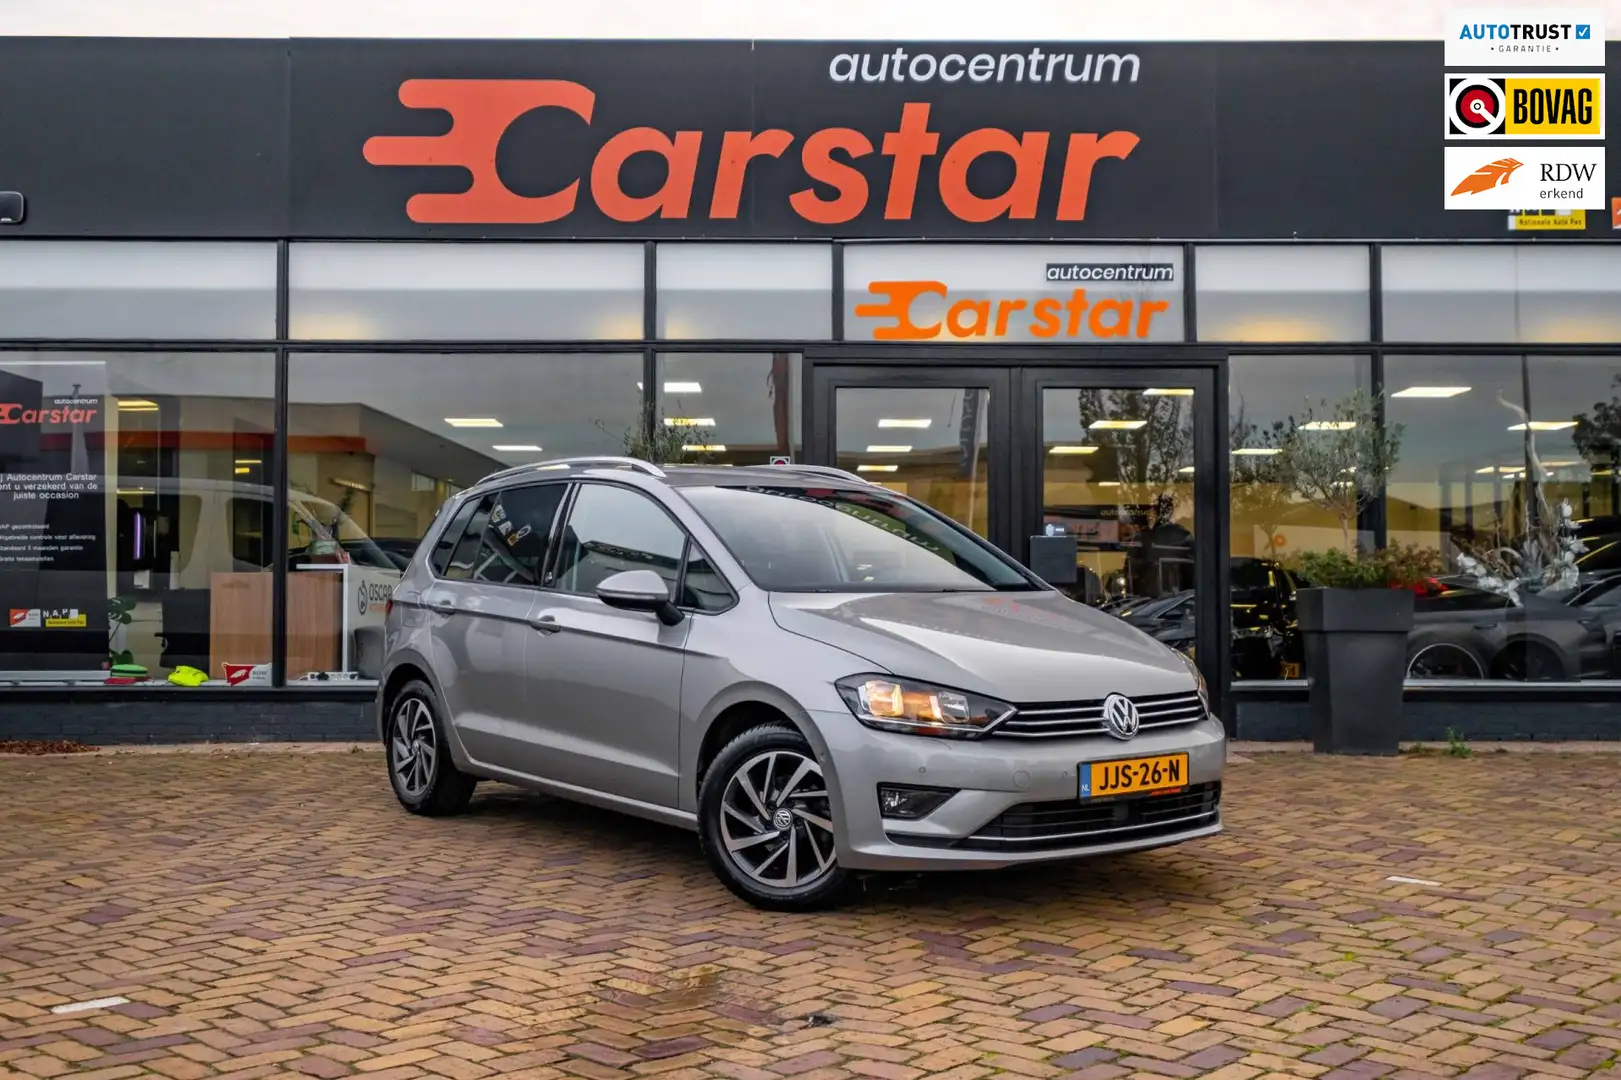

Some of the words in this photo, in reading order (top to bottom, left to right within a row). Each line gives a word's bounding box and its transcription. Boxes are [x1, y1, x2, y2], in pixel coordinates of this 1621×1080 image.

[829, 46, 1141, 85] autocentrum
[363, 78, 1141, 225] Carstar
[1047, 264, 1174, 281] autocentrum
[854, 280, 1169, 340] Carstar
[0, 402, 97, 425] Carstar
[6, 473, 63, 481] Autocentrum
[65, 473, 97, 481] Carstar
[14, 483, 20, 491] u
[23, 482, 66, 491] verzekerd
[87, 482, 98, 490] de
[13, 491, 36, 501] juiste
[38, 491, 80, 499] occasion
[1099, 759, 1180, 791] JJS-26-N
[1081, 784, 1090, 792] NL
